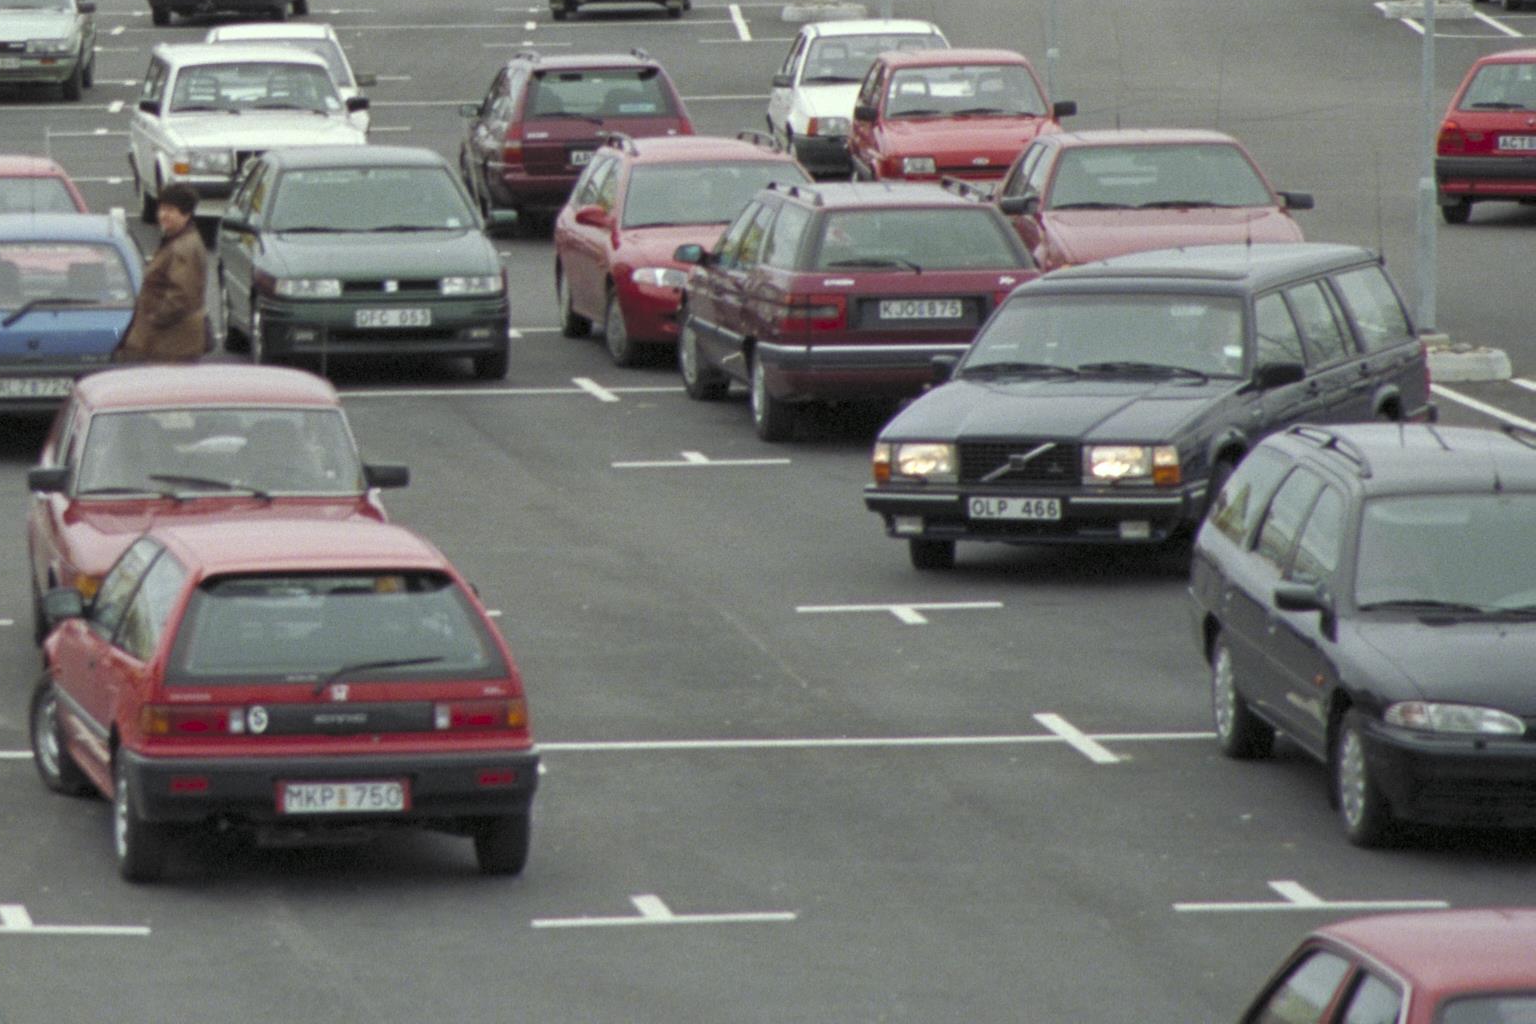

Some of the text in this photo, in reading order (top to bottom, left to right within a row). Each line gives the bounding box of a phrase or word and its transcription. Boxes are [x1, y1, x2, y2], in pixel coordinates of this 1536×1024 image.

[971, 500, 1058, 518] OLP 466
[287, 784, 402, 809] MKP 750
